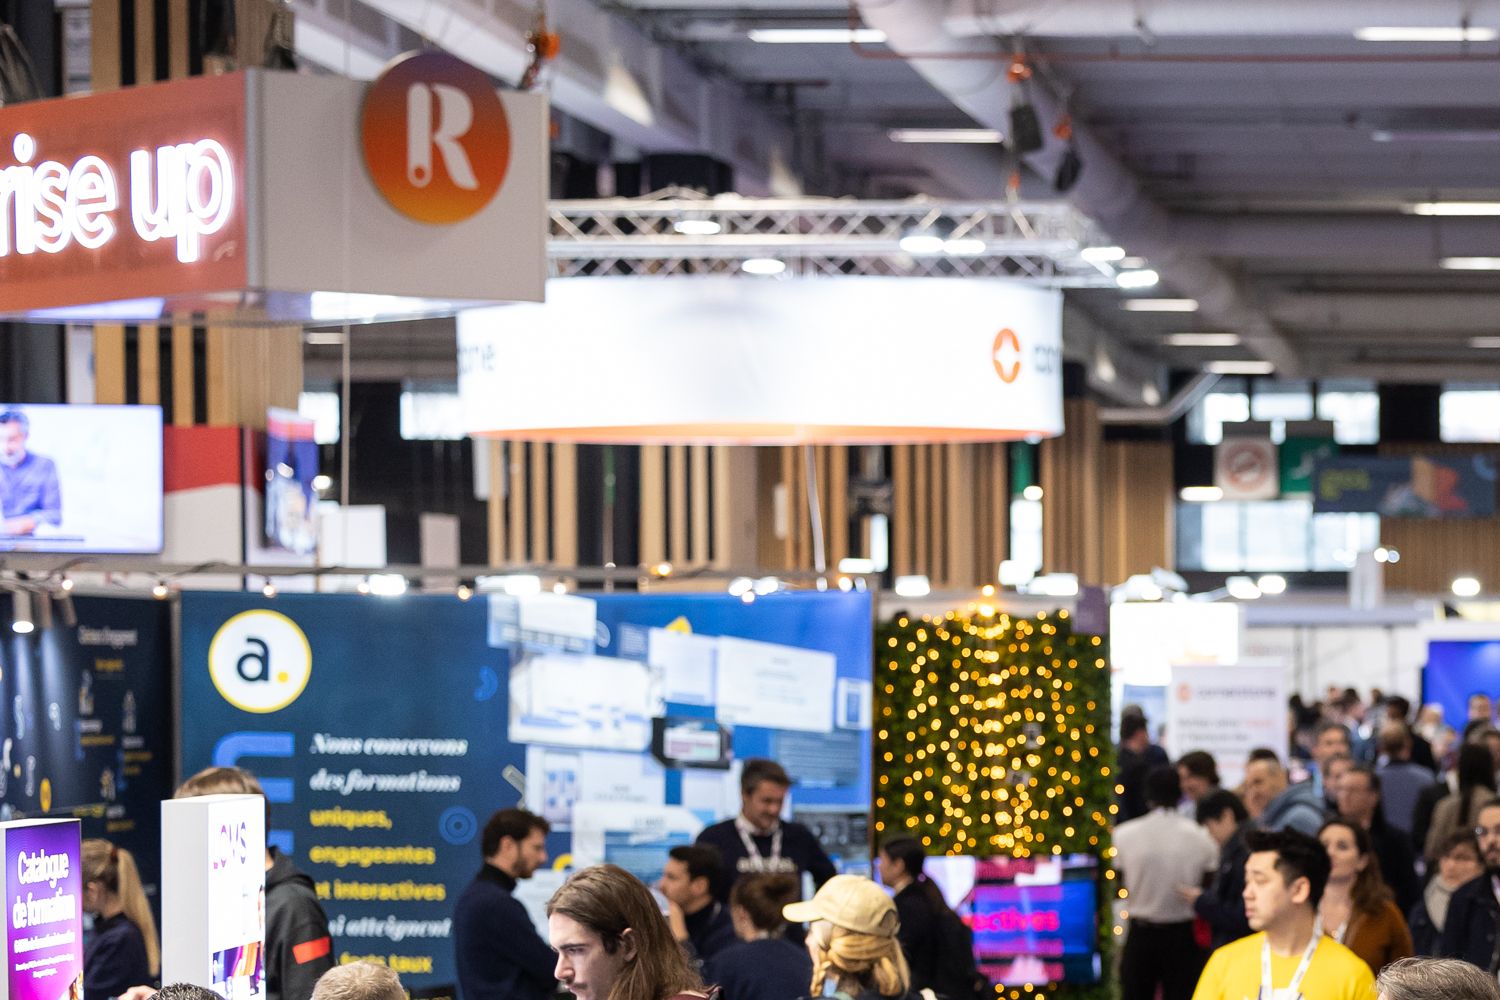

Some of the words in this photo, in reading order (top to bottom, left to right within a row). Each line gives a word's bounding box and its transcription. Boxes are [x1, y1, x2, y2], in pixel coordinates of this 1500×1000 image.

[407, 81, 479, 190] R
[130, 138, 233, 264] up
[310, 733, 363, 755] Nous
[363, 738, 469, 756] concevons
[309, 768, 345, 791] des
[340, 769, 462, 796] formations
[309, 806, 393, 831] uniques,
[17, 848, 70, 889] Catalogue
[309, 845, 437, 868] engageantes
[333, 879, 447, 901] interactives
[12, 895, 27, 930] de
[26, 887, 76, 927] formation
[328, 915, 346, 937] ui
[388, 955, 434, 975] taux
